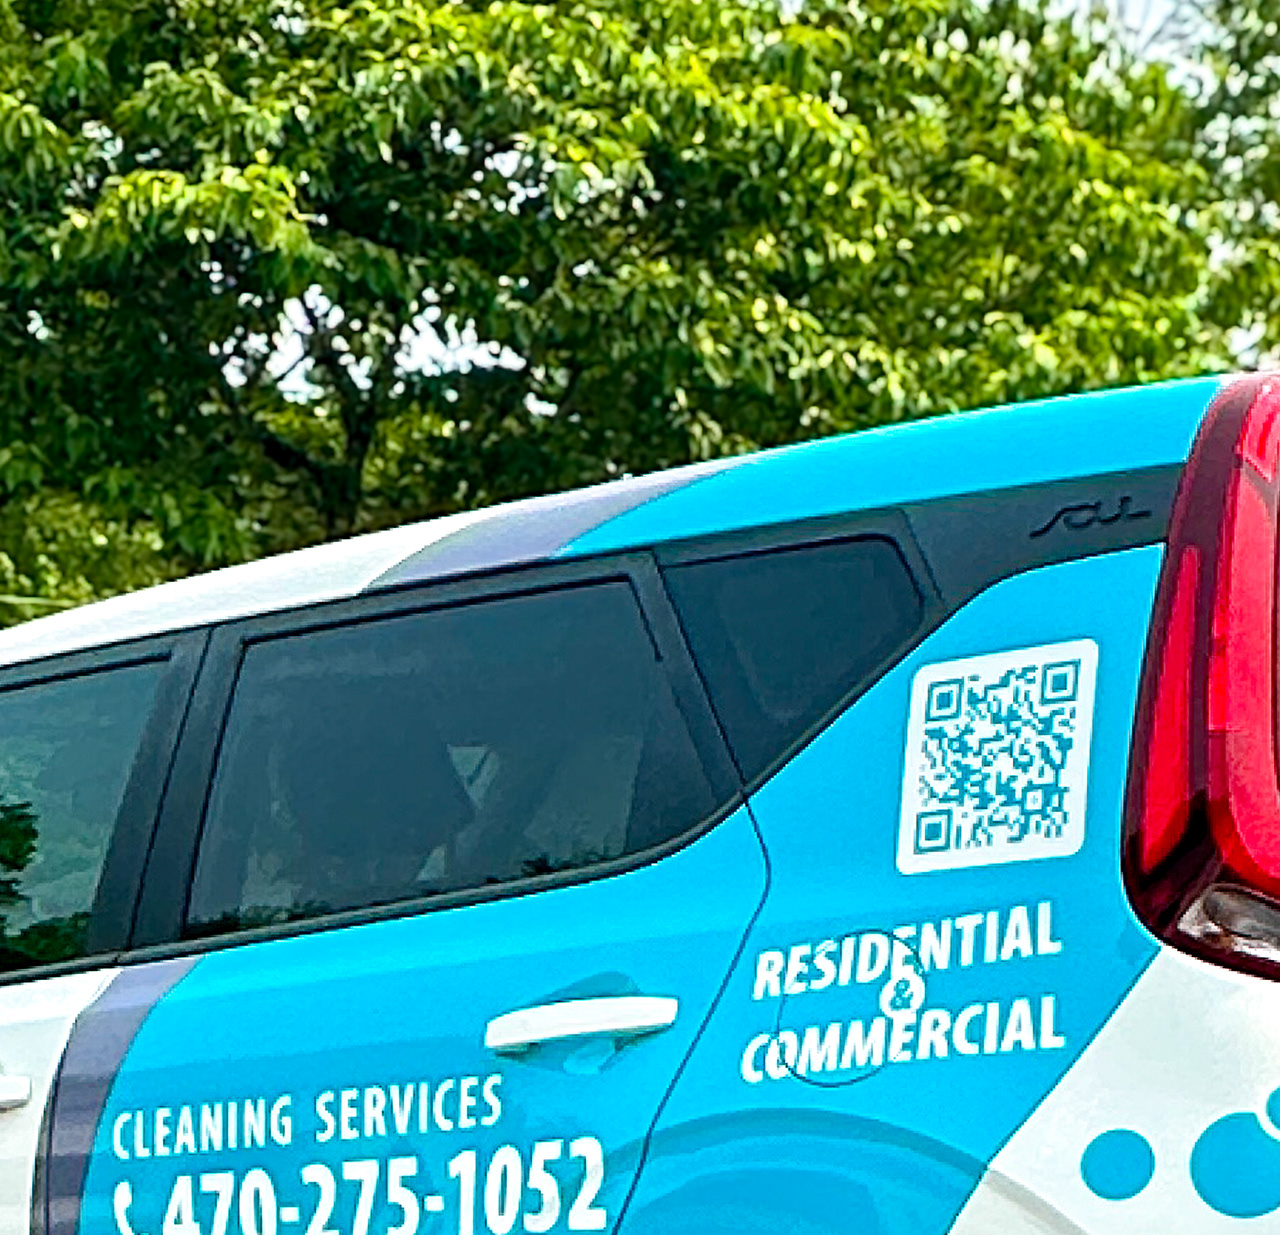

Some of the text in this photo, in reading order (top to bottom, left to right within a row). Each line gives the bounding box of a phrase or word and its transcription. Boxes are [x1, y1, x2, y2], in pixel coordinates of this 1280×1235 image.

[751, 901, 1064, 1000] RESIDENTIAL
[888, 976, 914, 1010] &
[740, 994, 1067, 1084] COMMERCIAL
[113, 1073, 503, 1160] CLEANING SERVICES
